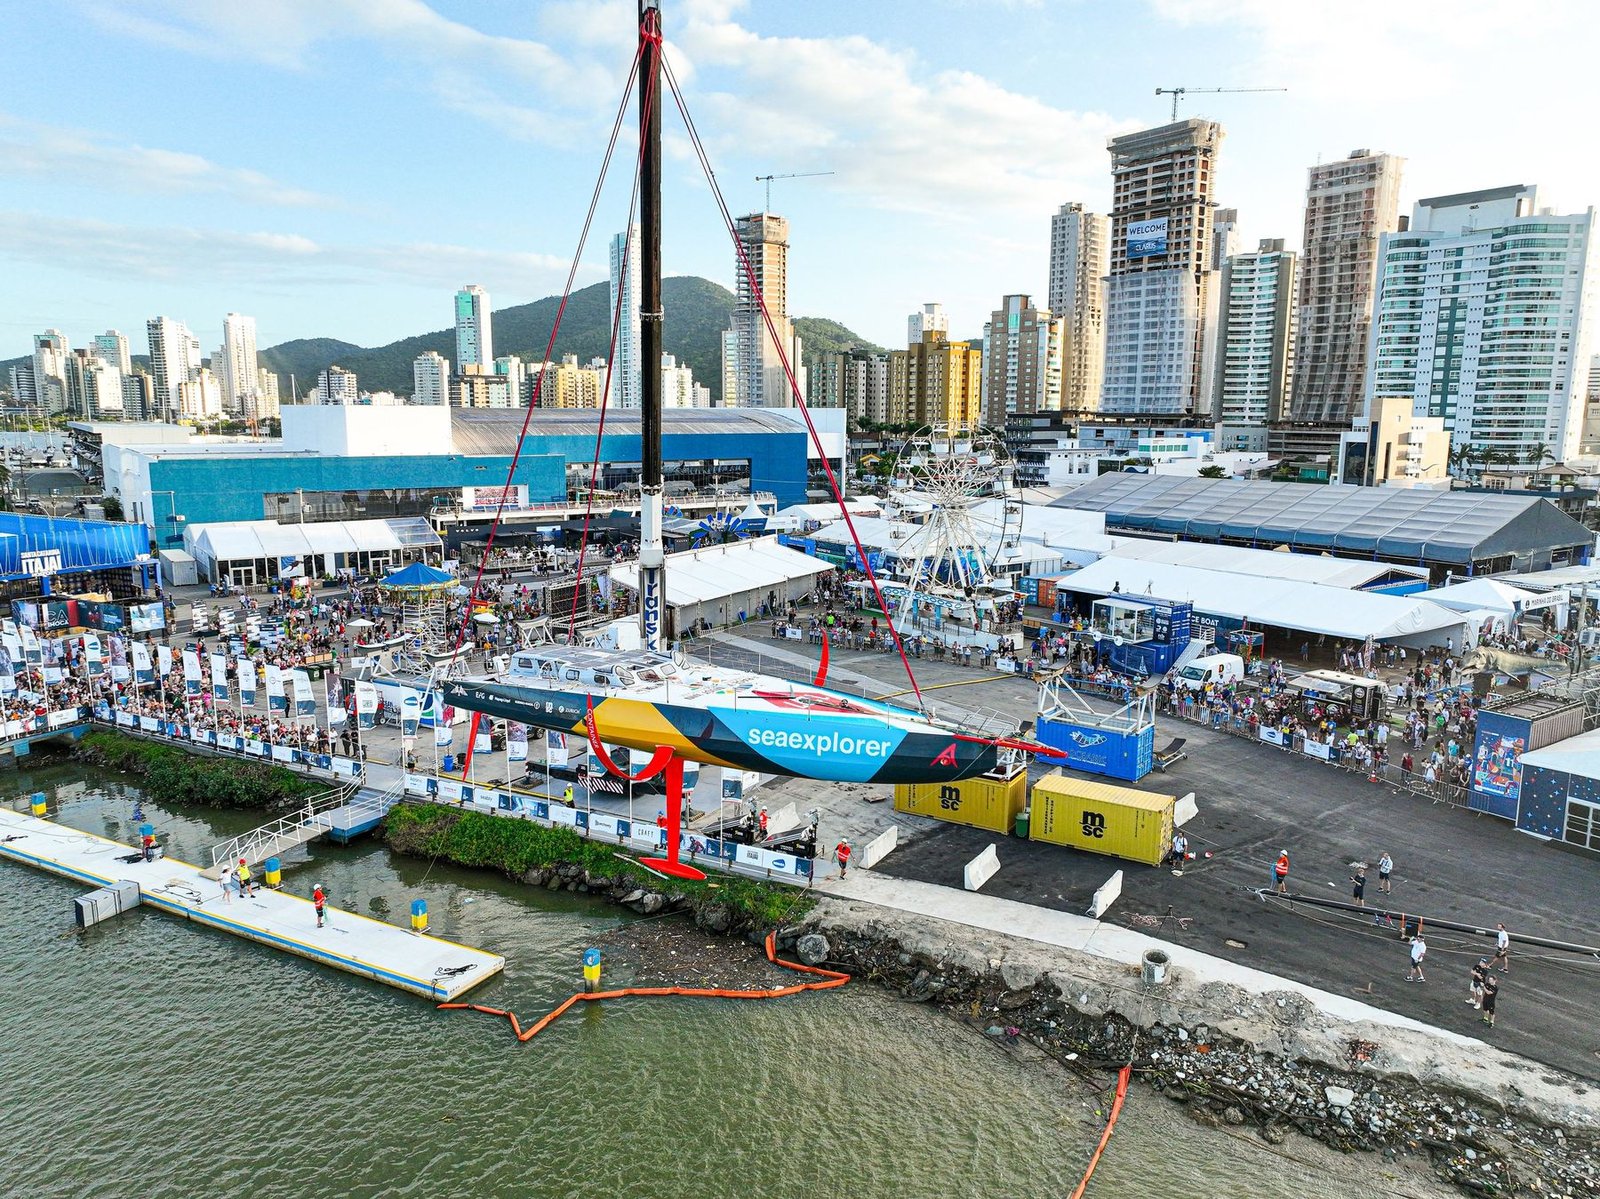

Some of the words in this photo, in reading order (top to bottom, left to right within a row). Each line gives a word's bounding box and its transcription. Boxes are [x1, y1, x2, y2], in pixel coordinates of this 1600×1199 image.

[1130, 223, 1166, 235] WELCOME
[1201, 616, 1220, 626] BOAT
[748, 727, 892, 758] seaexplorer
